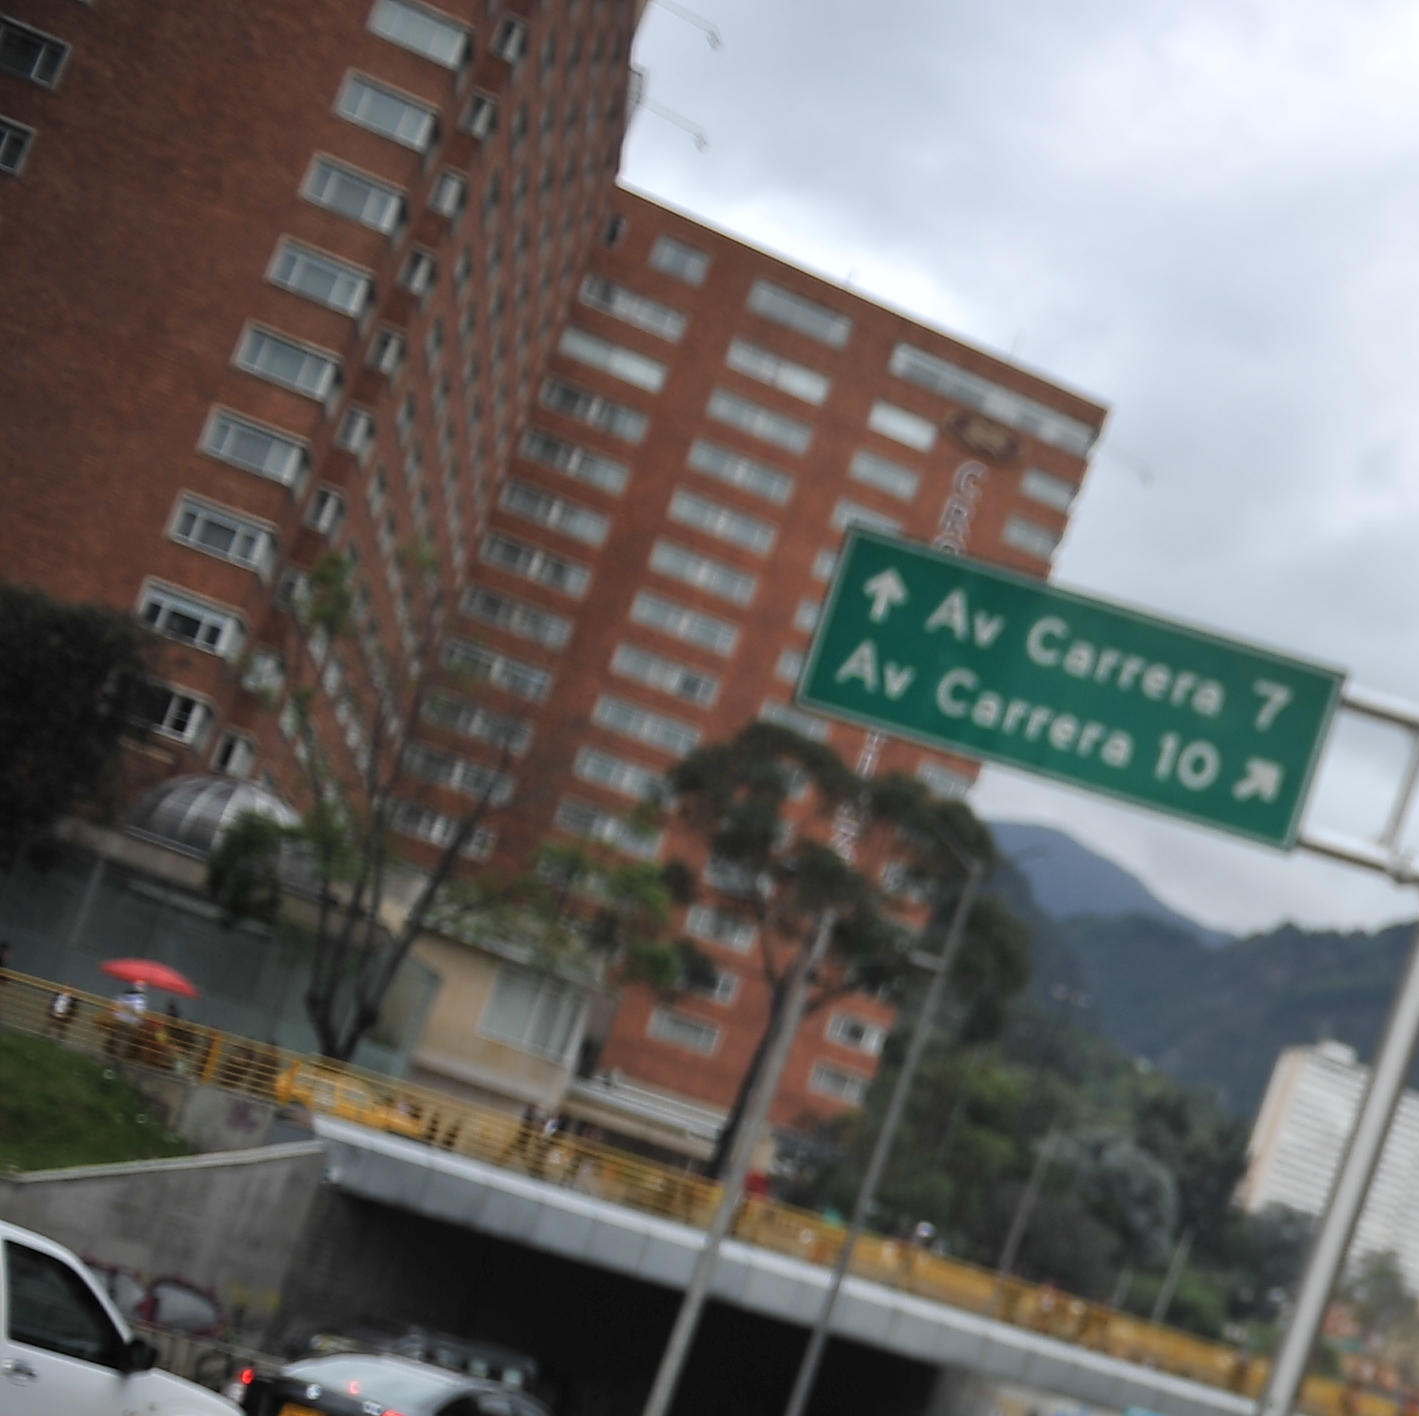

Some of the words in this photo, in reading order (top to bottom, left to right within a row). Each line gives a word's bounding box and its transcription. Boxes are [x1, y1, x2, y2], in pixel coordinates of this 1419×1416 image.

[835, 639, 914, 700] Av
[936, 668, 1134, 768] Carrera
[1154, 734, 1220, 791] 10
[926, 589, 1005, 648] Av
[1026, 617, 1226, 719] Carrera
[1253, 678, 1295, 732] 7
